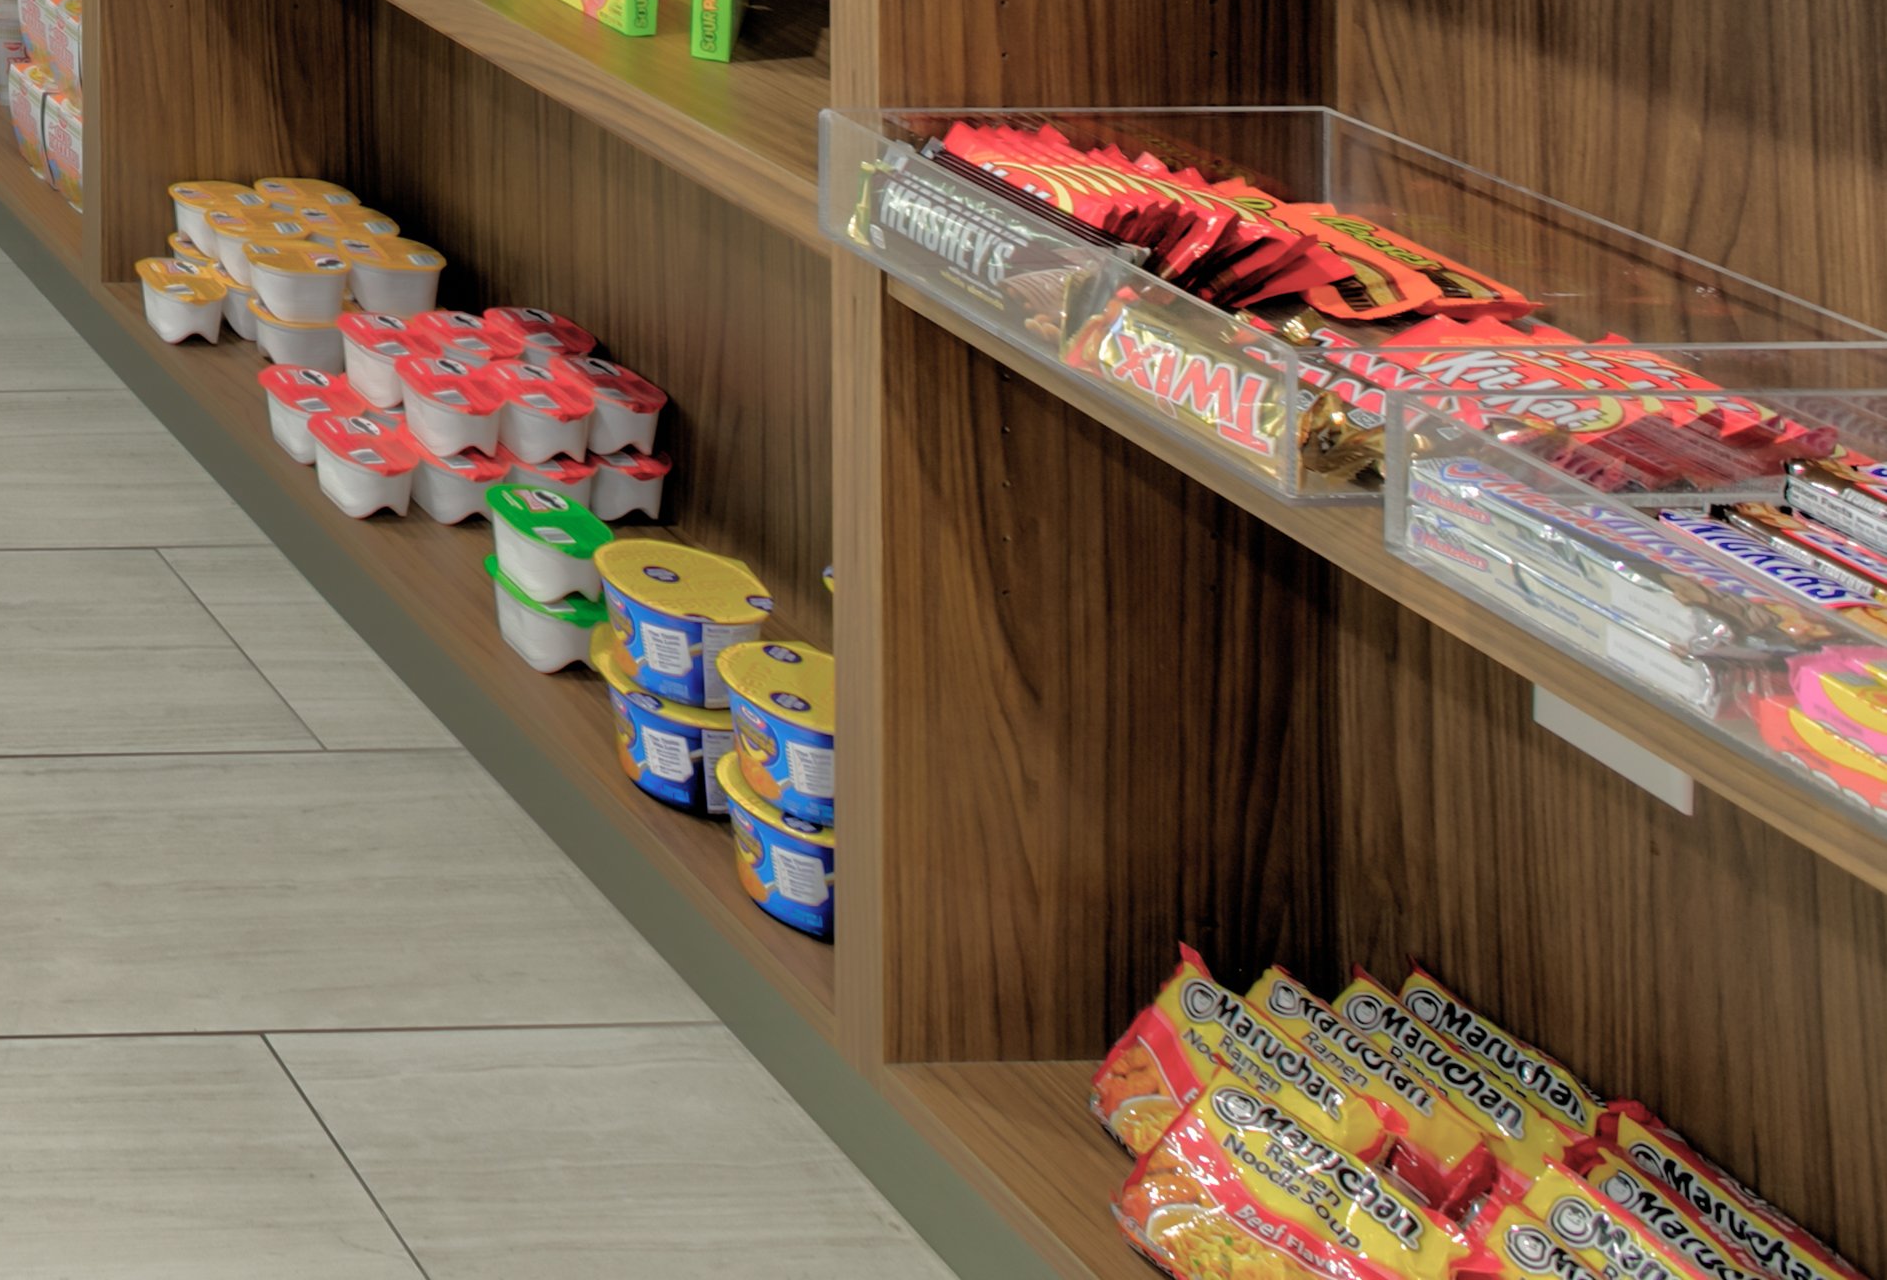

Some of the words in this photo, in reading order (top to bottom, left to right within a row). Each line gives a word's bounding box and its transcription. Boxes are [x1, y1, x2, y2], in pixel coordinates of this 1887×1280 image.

[701, 11, 717, 53] SOUR
[879, 168, 1016, 284] HERSHEY'S
[1113, 330, 1277, 456] TWIX
[1214, 993, 1347, 1121] Maruchan
[1219, 1038, 1283, 1094] Ramen
[1379, 1006, 1526, 1140] Maruchan
[1443, 1002, 1587, 1126] Maruchan
[1223, 1132, 1303, 1201] Noodle
[1301, 1191, 1362, 1250] Soup
[1258, 1107, 1424, 1250] Maruchan
[1265, 1142, 1343, 1208] Ramen
[1664, 1157, 1827, 1280] Marucha
[1234, 1204, 1285, 1241] Beef
[1286, 1232, 1356, 1277] Flavor
